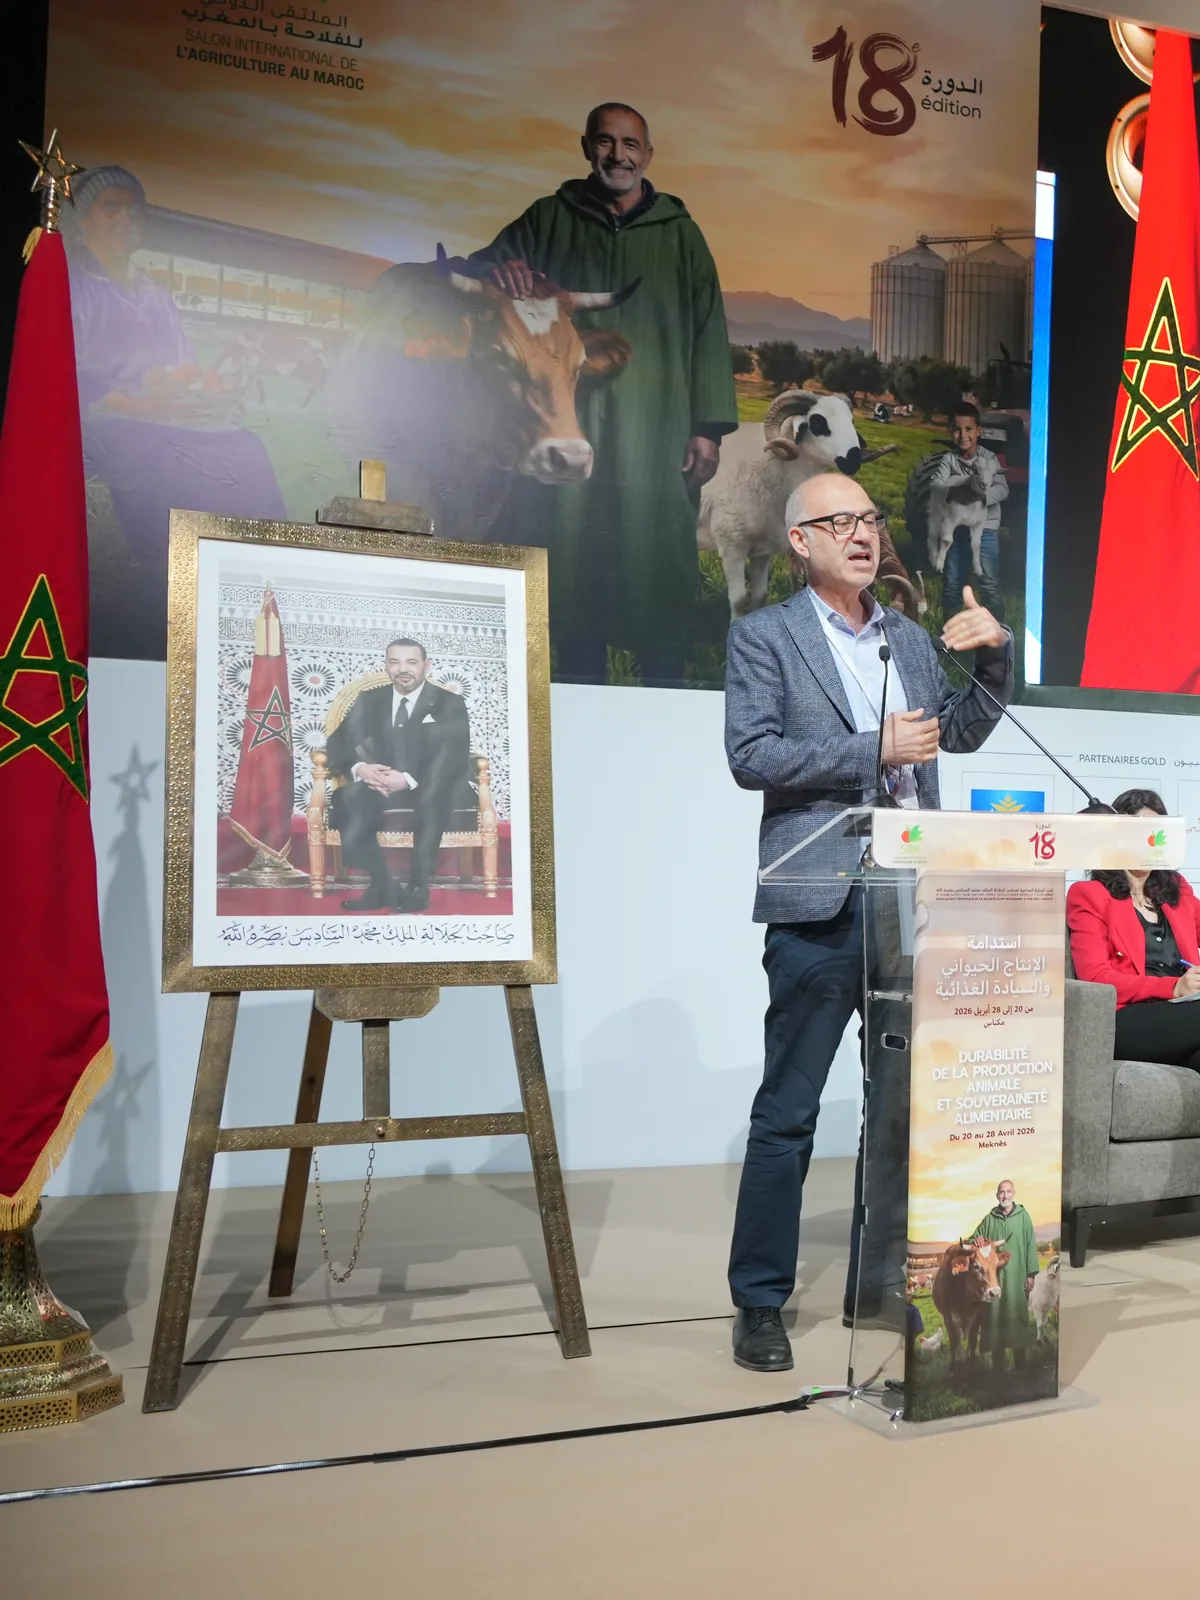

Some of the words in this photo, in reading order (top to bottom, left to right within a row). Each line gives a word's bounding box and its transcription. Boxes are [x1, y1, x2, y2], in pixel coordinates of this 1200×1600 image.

[181, 7, 279, 37] بالمغرب
[271, 6, 348, 28] الملتقى
[284, 22, 364, 49] للفلاحة
[185, 28, 231, 48] SALON
[236, 38, 336, 68] INTERNATIONAL
[340, 57, 358, 71] DE
[176, 45, 286, 76] L'AGRICULTURE
[290, 66, 309, 80] AU
[314, 70, 365, 90] MAROC
[921, 70, 983, 95] الدورة
[921, 95, 982, 119] édition
[1078, 753, 1140, 766] PARTENAIRES
[1140, 756, 1166, 767] GOLD
[967, 934, 1021, 950] استدامة
[941, 957, 999, 978] الحيواني
[1003, 956, 1045, 977] الإنتاج
[935, 980, 989, 1001] الغذائية
[993, 979, 1050, 998] والسيادة
[954, 1007, 972, 1015] 2026
[974, 1004, 990, 1017] أبريل
[991, 1006, 1001, 1014] 28
[1002, 1005, 1013, 1016] إلى
[1014, 1005, 1023, 1013] 20
[1024, 1006, 1034, 1014] من
[983, 1018, 1005, 1028] مكناس
[958, 1044, 1029, 1064] DURABILITÉ
[932, 1068, 949, 1081] DE
[952, 1068, 969, 1079] LA
[973, 1061, 1053, 1078] PRODUCTION
[966, 1078, 1021, 1093] ANIMALE
[936, 1098, 951, 1111] ET
[955, 1089, 1048, 1110] SOUVERAINETÉ
[954, 1107, 1032, 1125] ALIMENTAIRE
[949, 1133, 960, 1142] Du
[962, 1132, 972, 1140] 20
[974, 1132, 984, 1140] au
[986, 1130, 996, 1138] 28
[998, 1128, 1015, 1138] Avril
[1016, 1126, 1035, 1136] 2026
[978, 1139, 1007, 1150] Meknès
